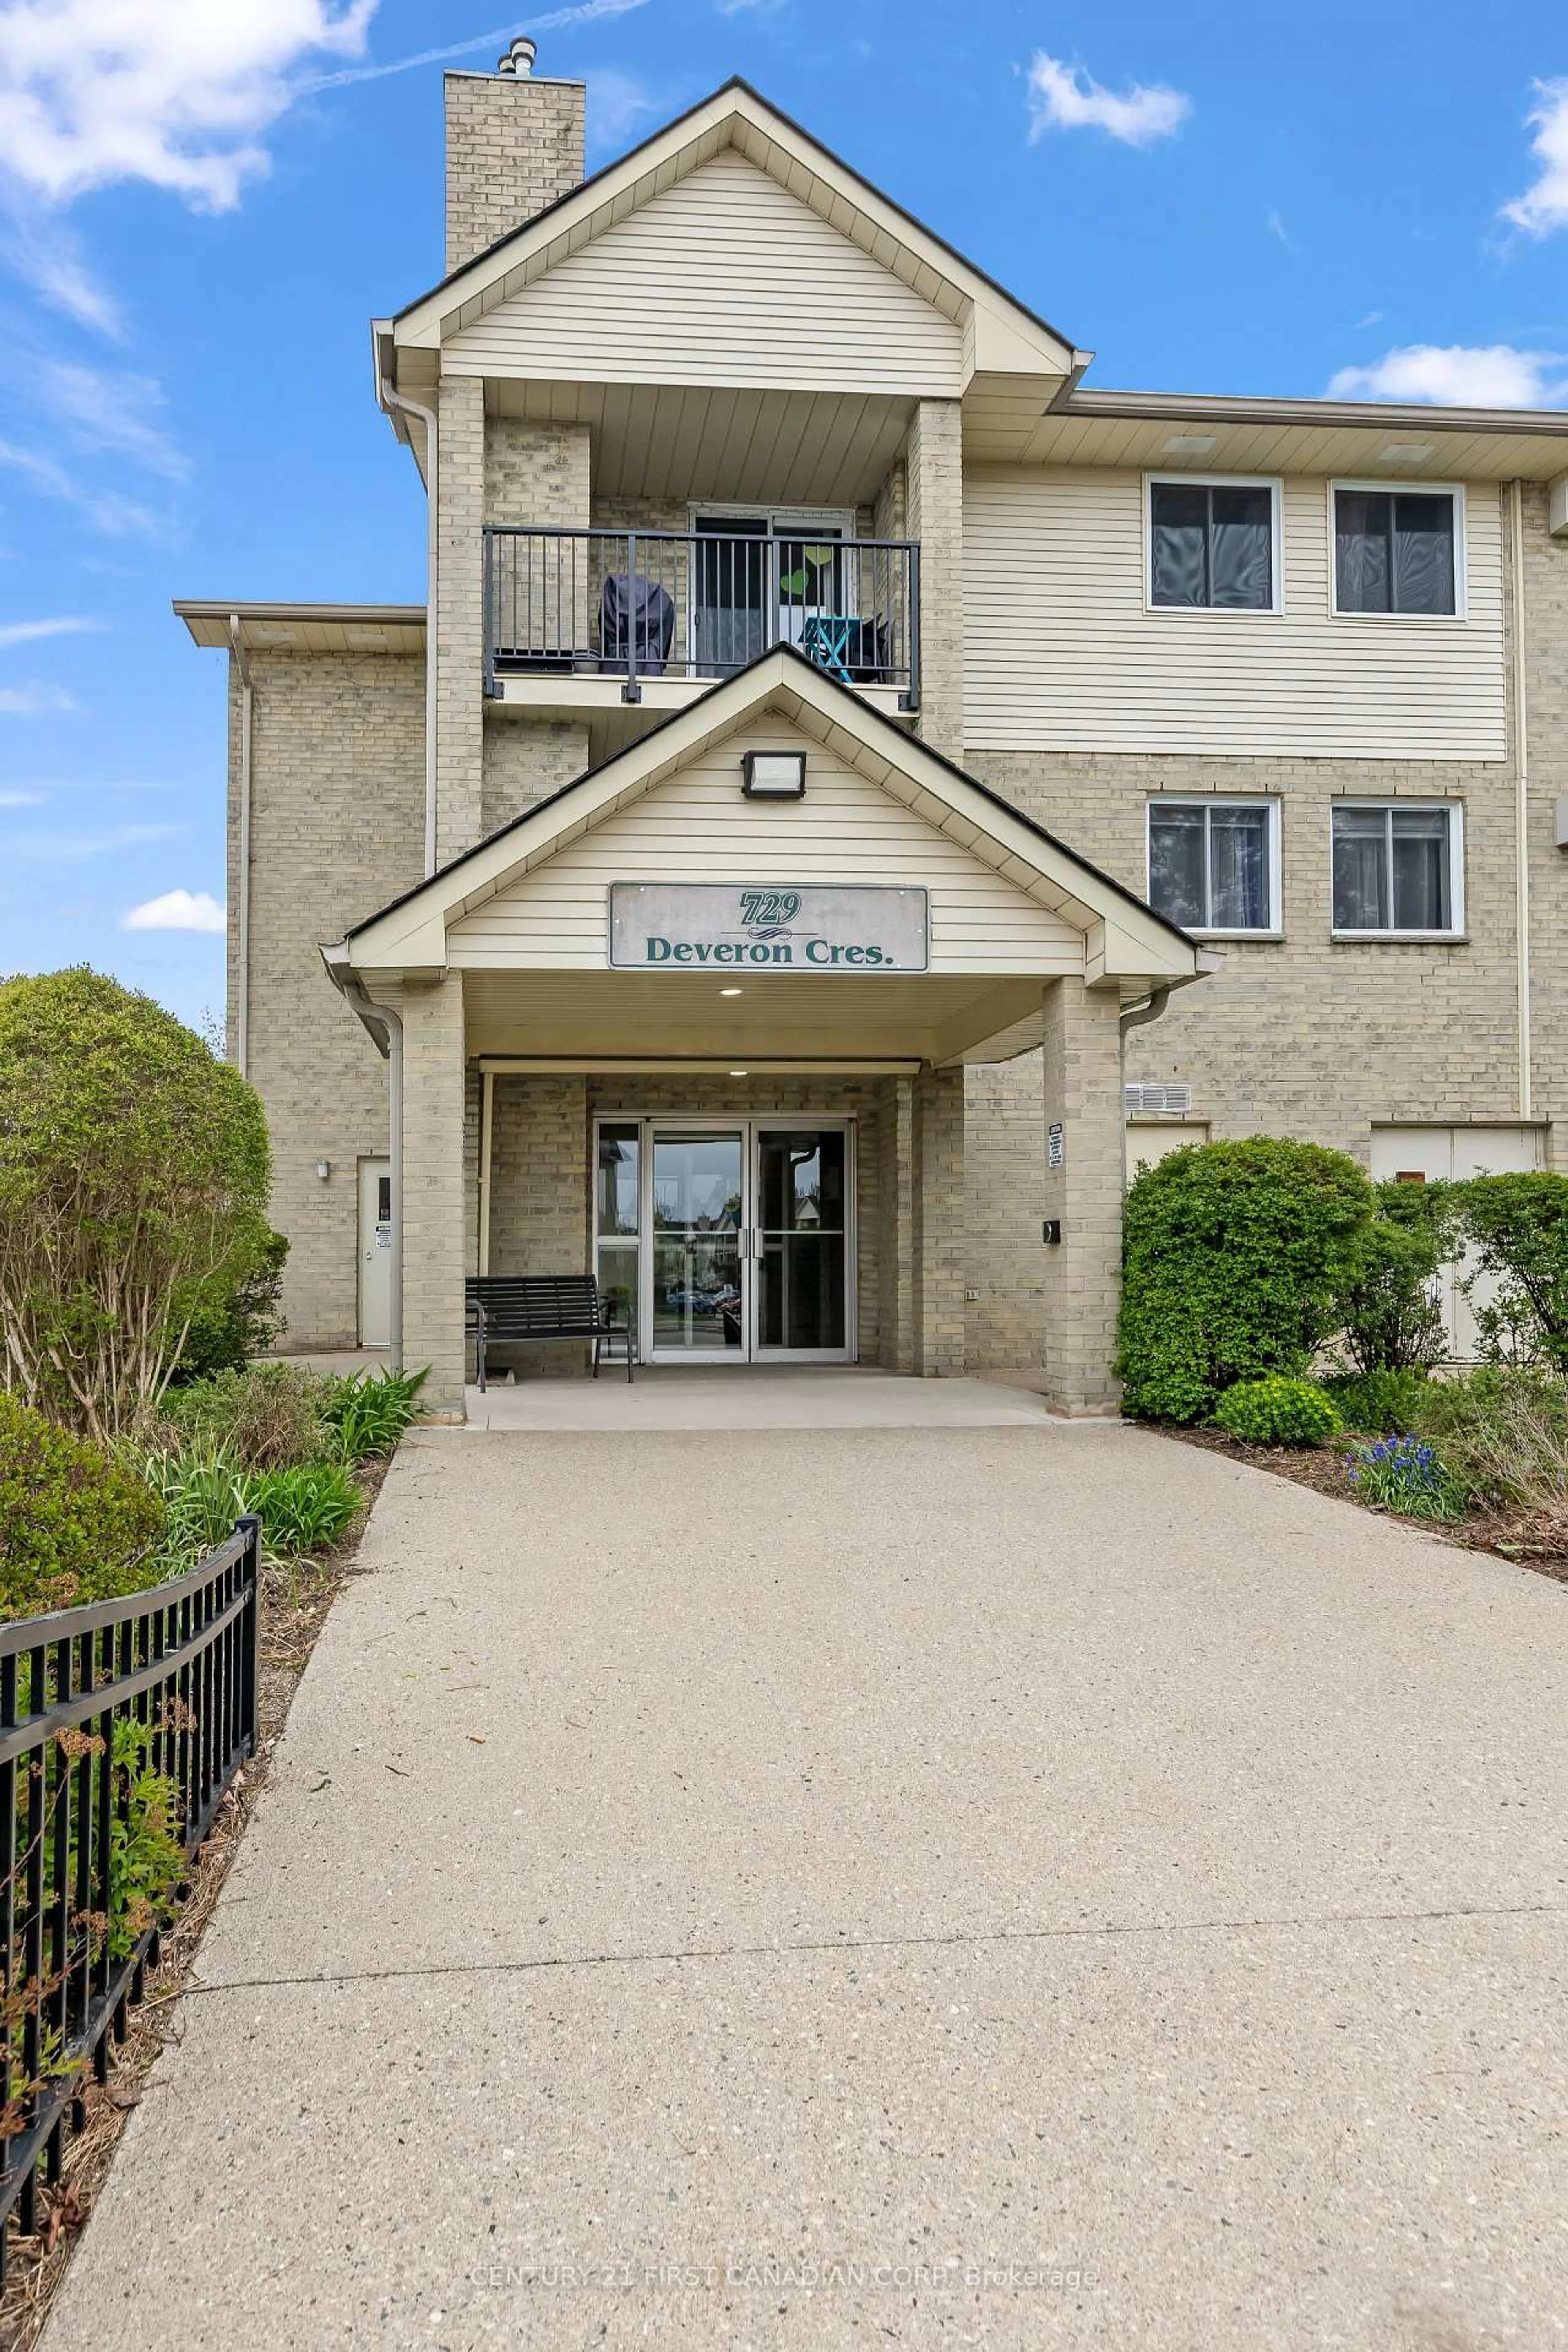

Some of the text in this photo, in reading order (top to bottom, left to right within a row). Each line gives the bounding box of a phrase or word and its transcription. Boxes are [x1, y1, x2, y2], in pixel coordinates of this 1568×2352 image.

[739, 892, 802, 925] 729
[646, 936, 894, 965] Deveron Cres.
